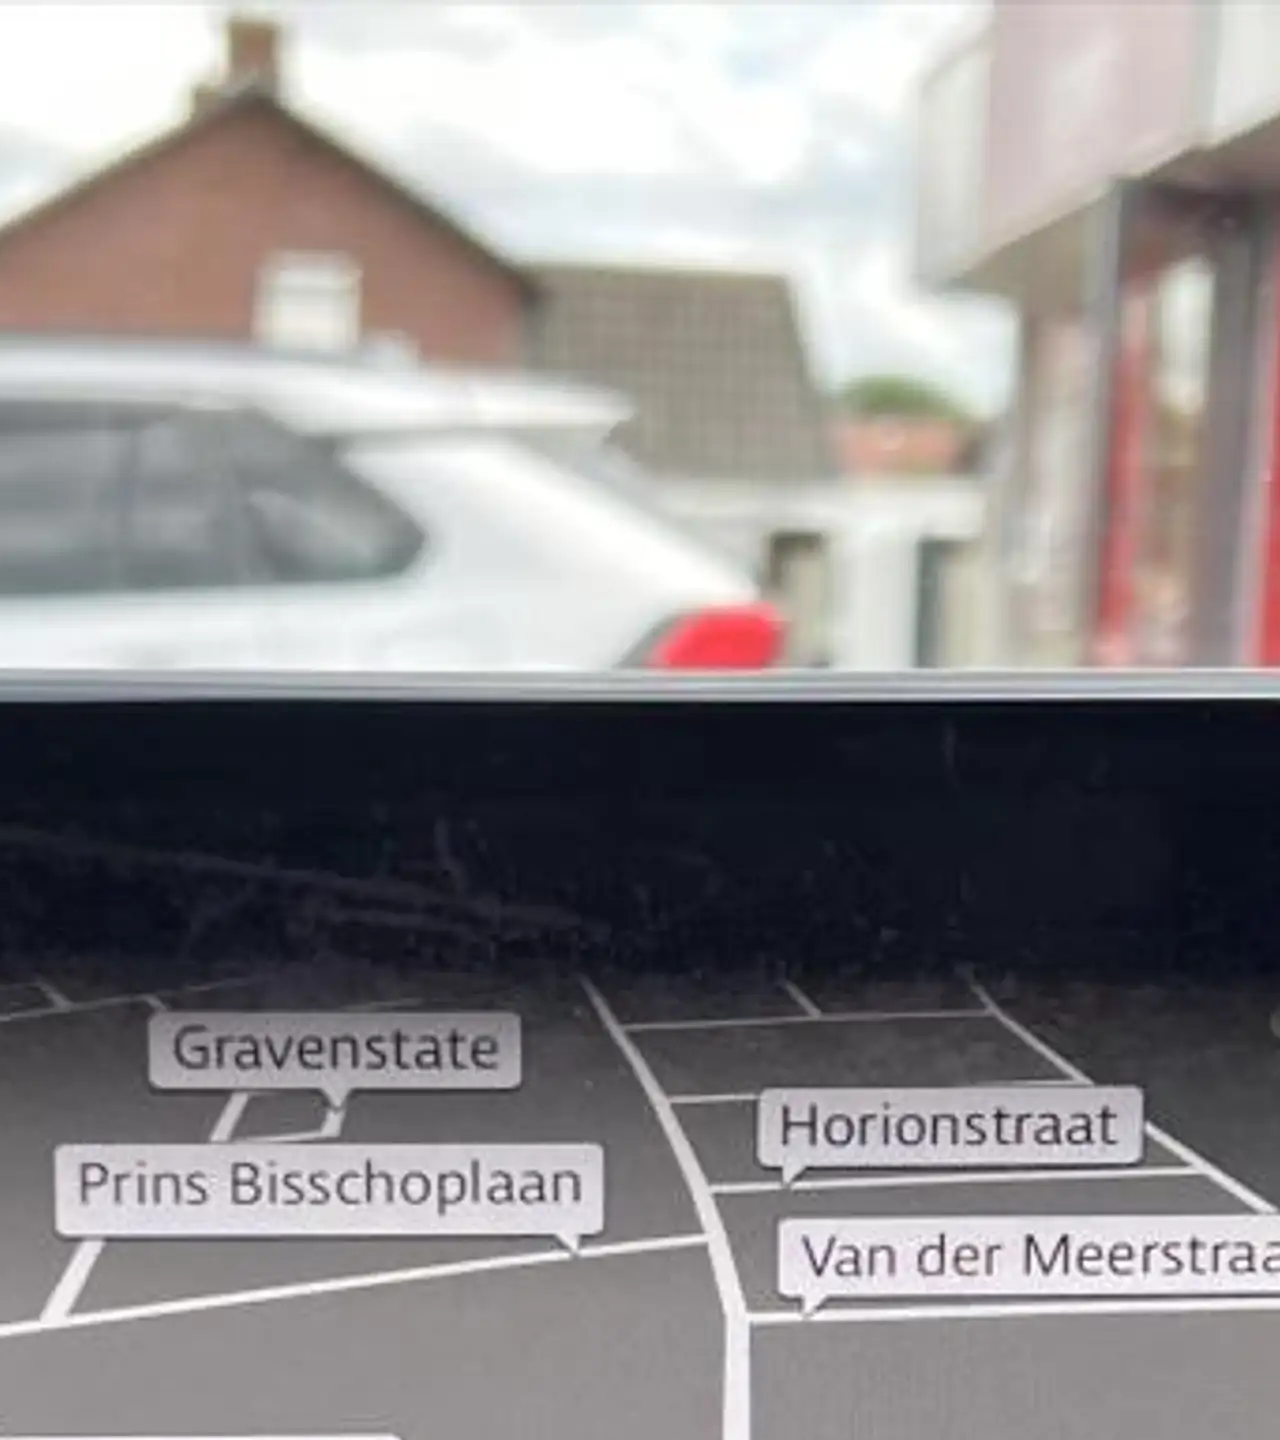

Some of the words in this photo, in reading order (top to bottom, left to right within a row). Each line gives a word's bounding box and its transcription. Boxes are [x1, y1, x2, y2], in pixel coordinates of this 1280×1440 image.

[172, 1025, 501, 1072] Gravenstate
[780, 1103, 1120, 1148] Horionstraat
[79, 1161, 208, 1205] Prins
[230, 1161, 583, 1216] Bisschoplaan
[801, 1235, 895, 1278] Van
[917, 1232, 1002, 1276] der
